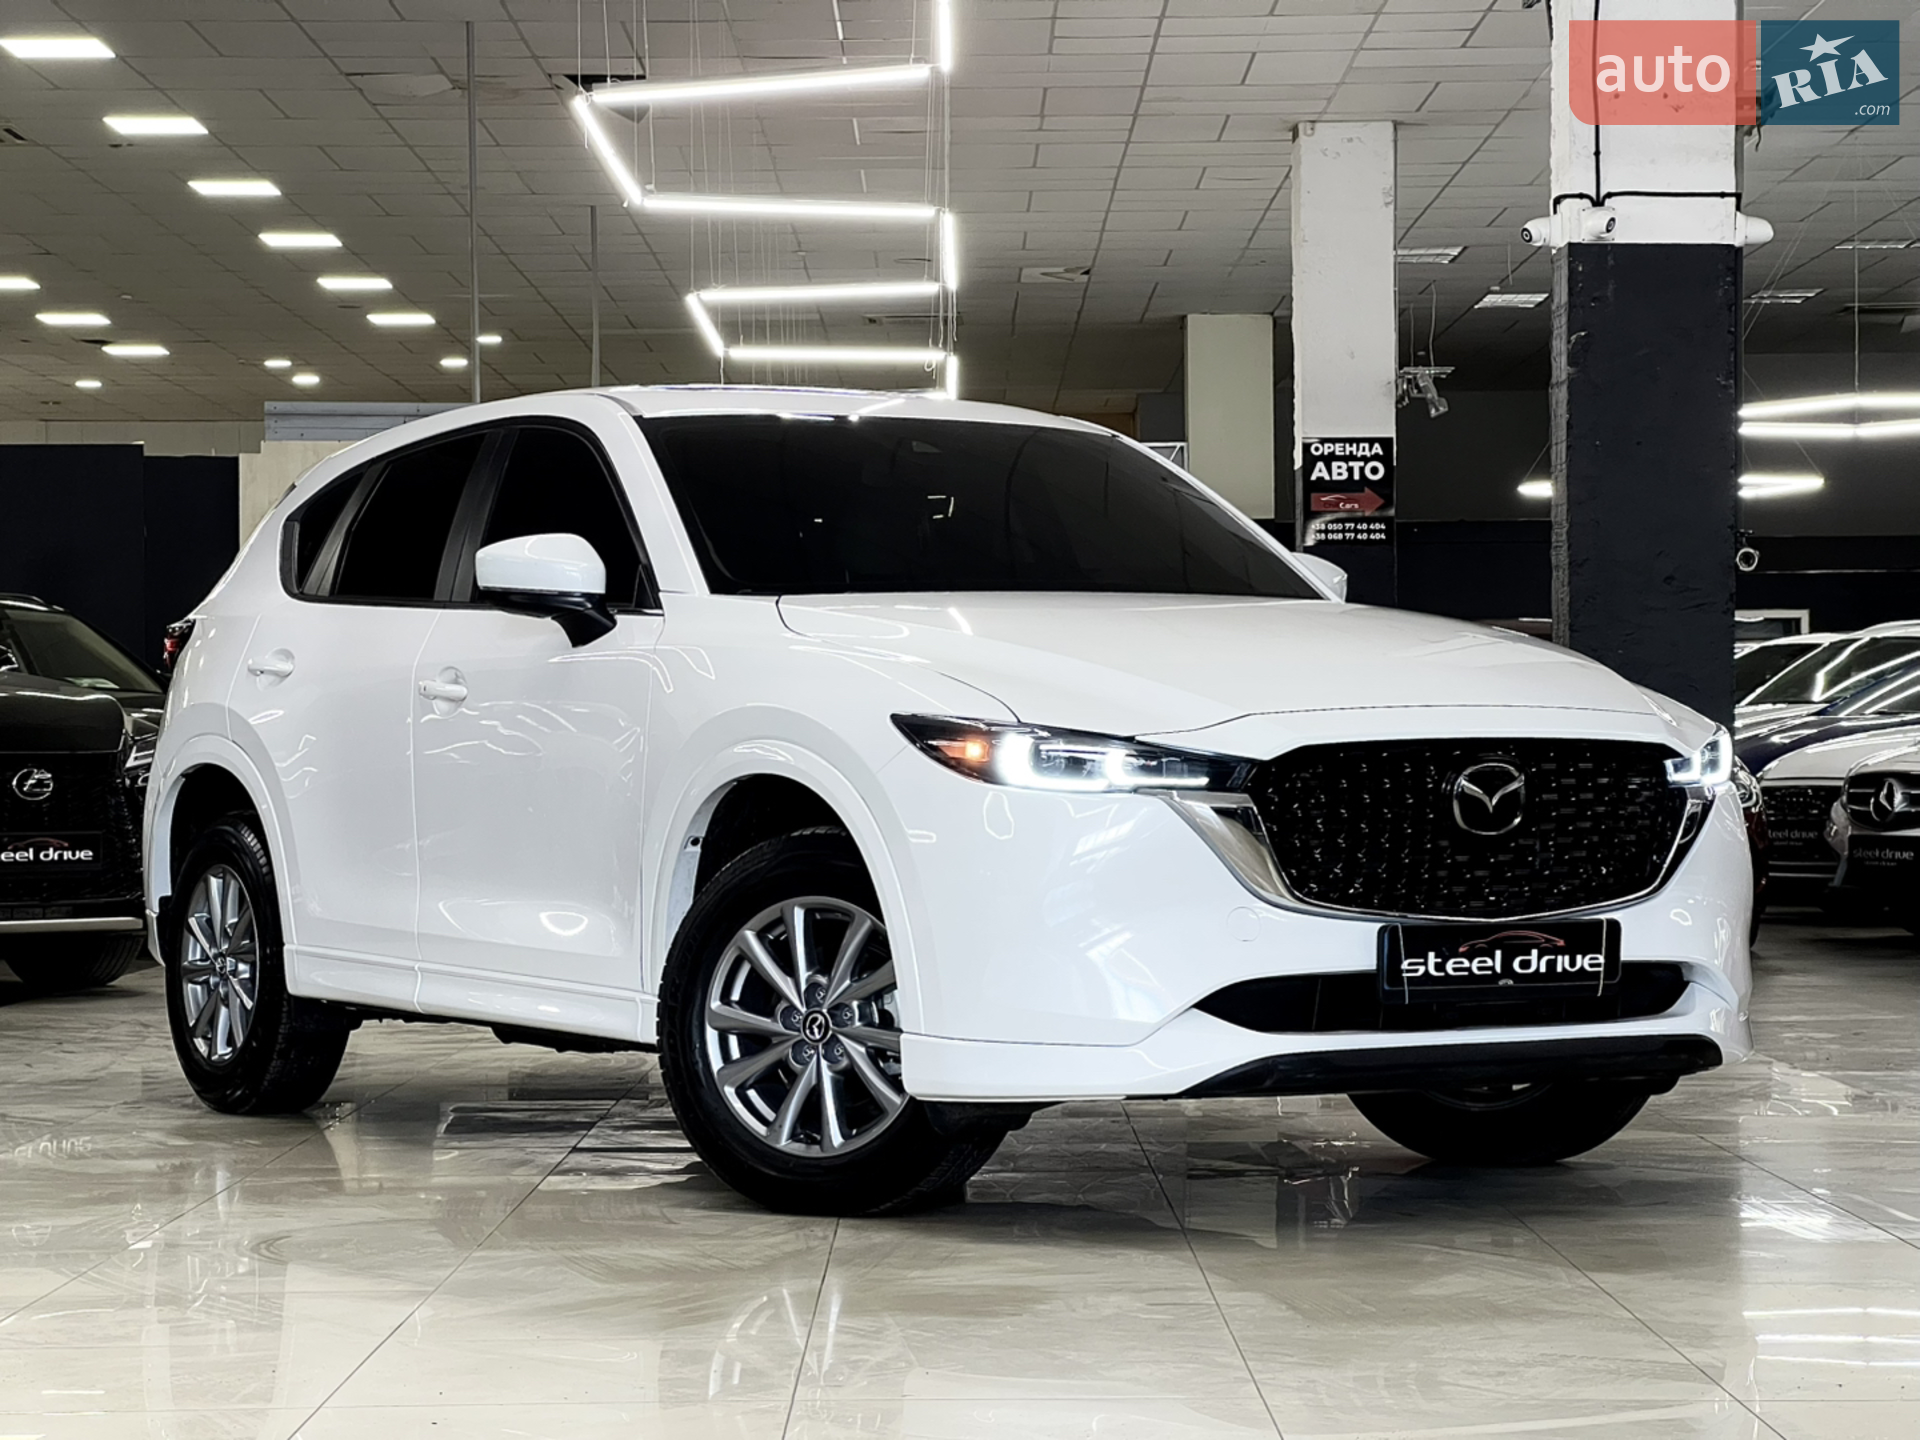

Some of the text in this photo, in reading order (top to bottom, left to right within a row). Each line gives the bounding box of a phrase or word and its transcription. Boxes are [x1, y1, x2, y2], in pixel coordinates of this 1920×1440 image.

[1310, 442, 1384, 458] ОРЕНДА
[1310, 460, 1385, 481] АВТО
[0, 847, 94, 862] eel drive
[1881, 848, 1915, 861] drive
[1401, 948, 1605, 977] steel drive
